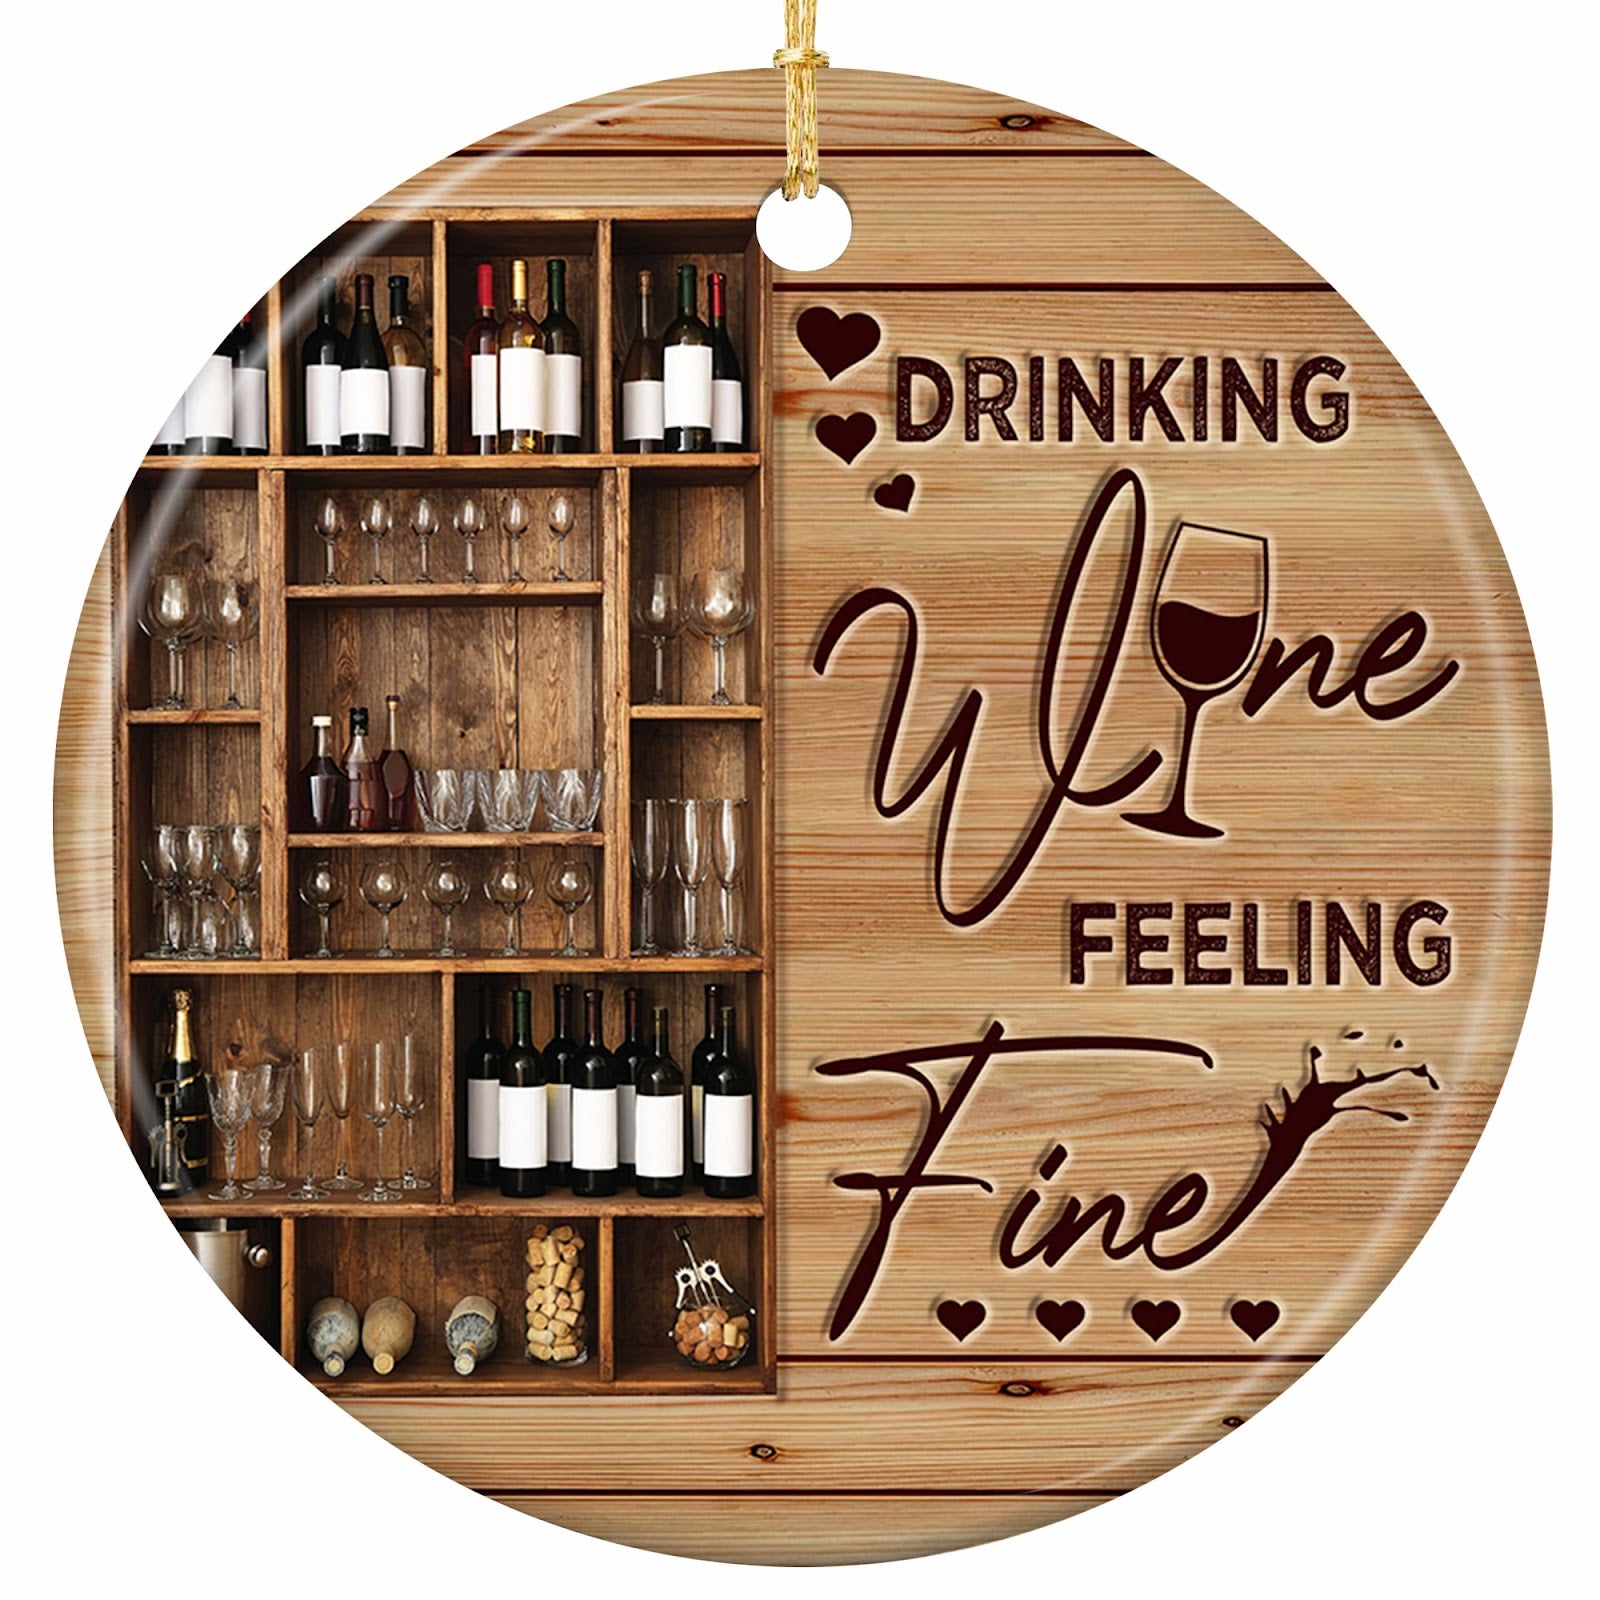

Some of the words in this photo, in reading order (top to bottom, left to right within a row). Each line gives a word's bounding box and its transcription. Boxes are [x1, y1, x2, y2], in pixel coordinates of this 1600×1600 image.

[895, 356, 1350, 443] DRINKING
[813, 468, 1459, 927] Wine
[1069, 900, 1452, 987] FEELING
[815, 1020, 1438, 1341] Fine
